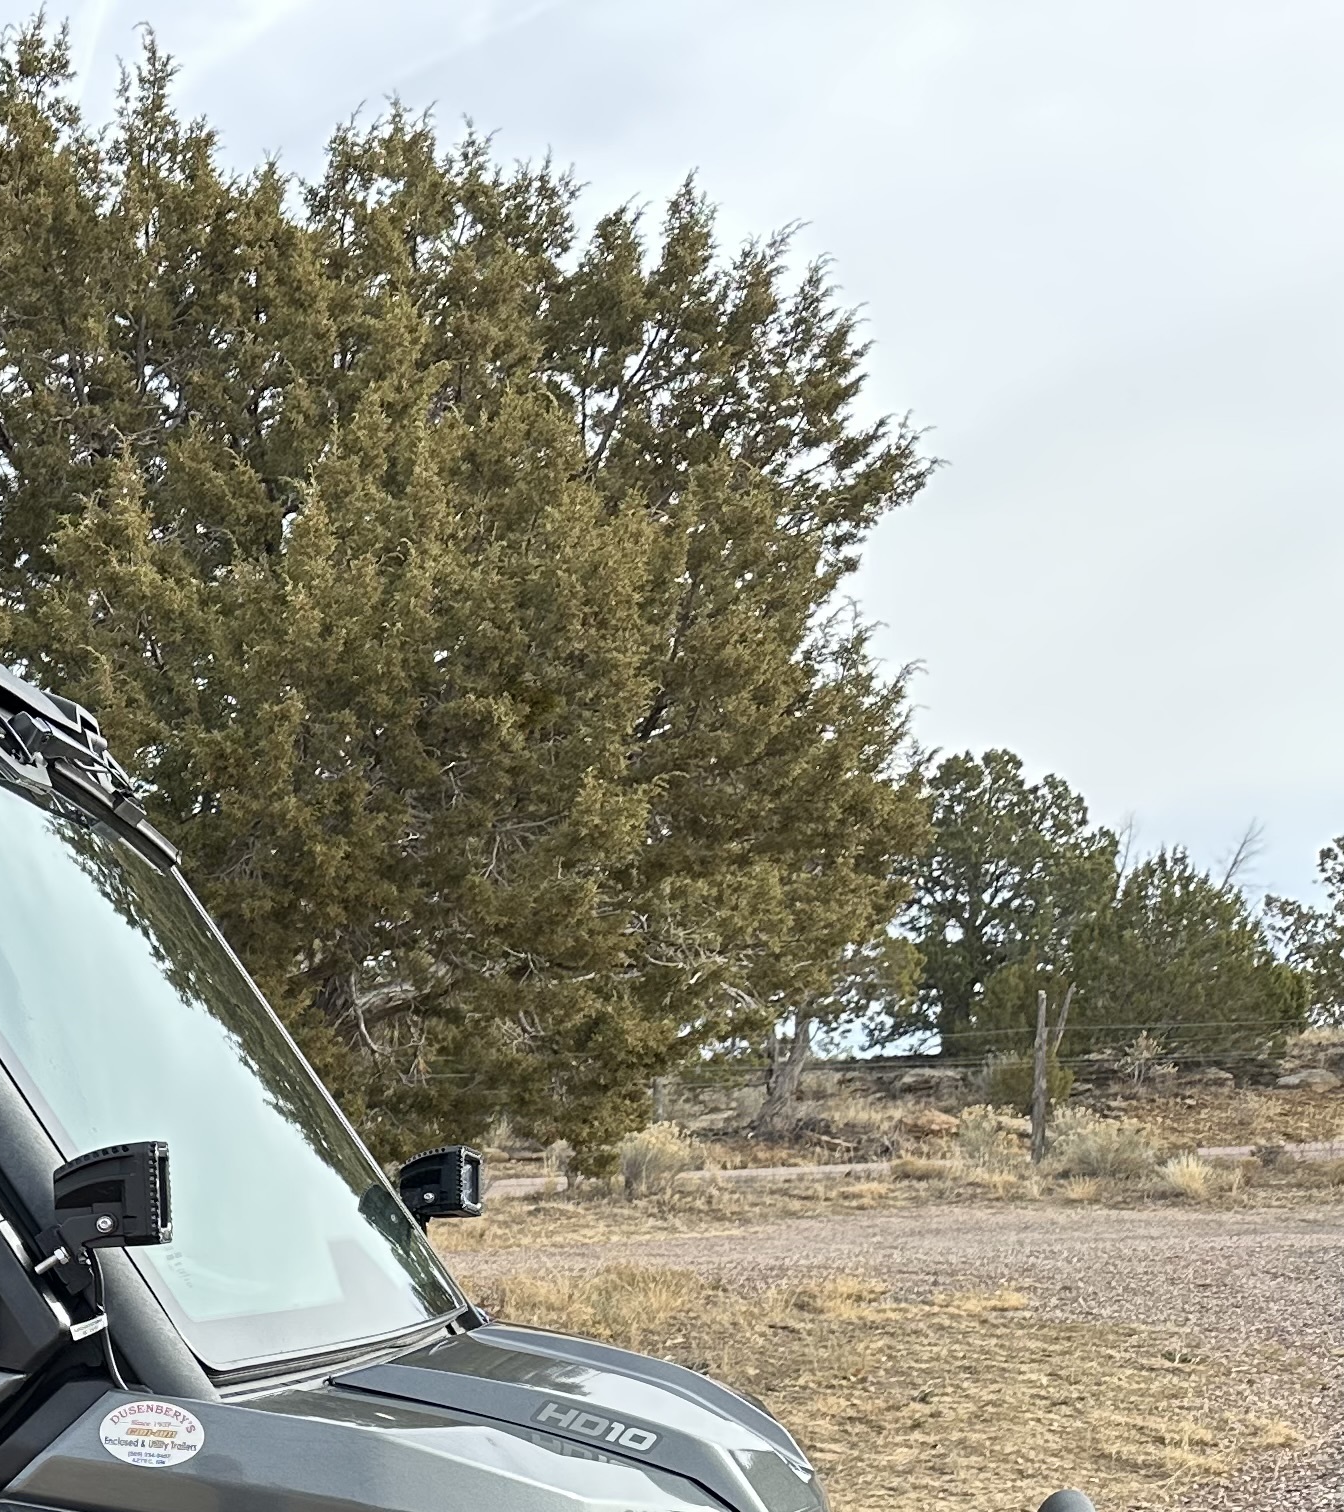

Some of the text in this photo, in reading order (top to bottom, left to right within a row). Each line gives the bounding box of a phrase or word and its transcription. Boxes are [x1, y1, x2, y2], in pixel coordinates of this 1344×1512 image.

[110, 1404, 196, 1433] DUSENBERY'S
[536, 1402, 658, 1451] HD10
[104, 1436, 139, 1447] Enclosed
[141, 1440, 146, 1448] &
[171, 1441, 197, 1451] Trailers
